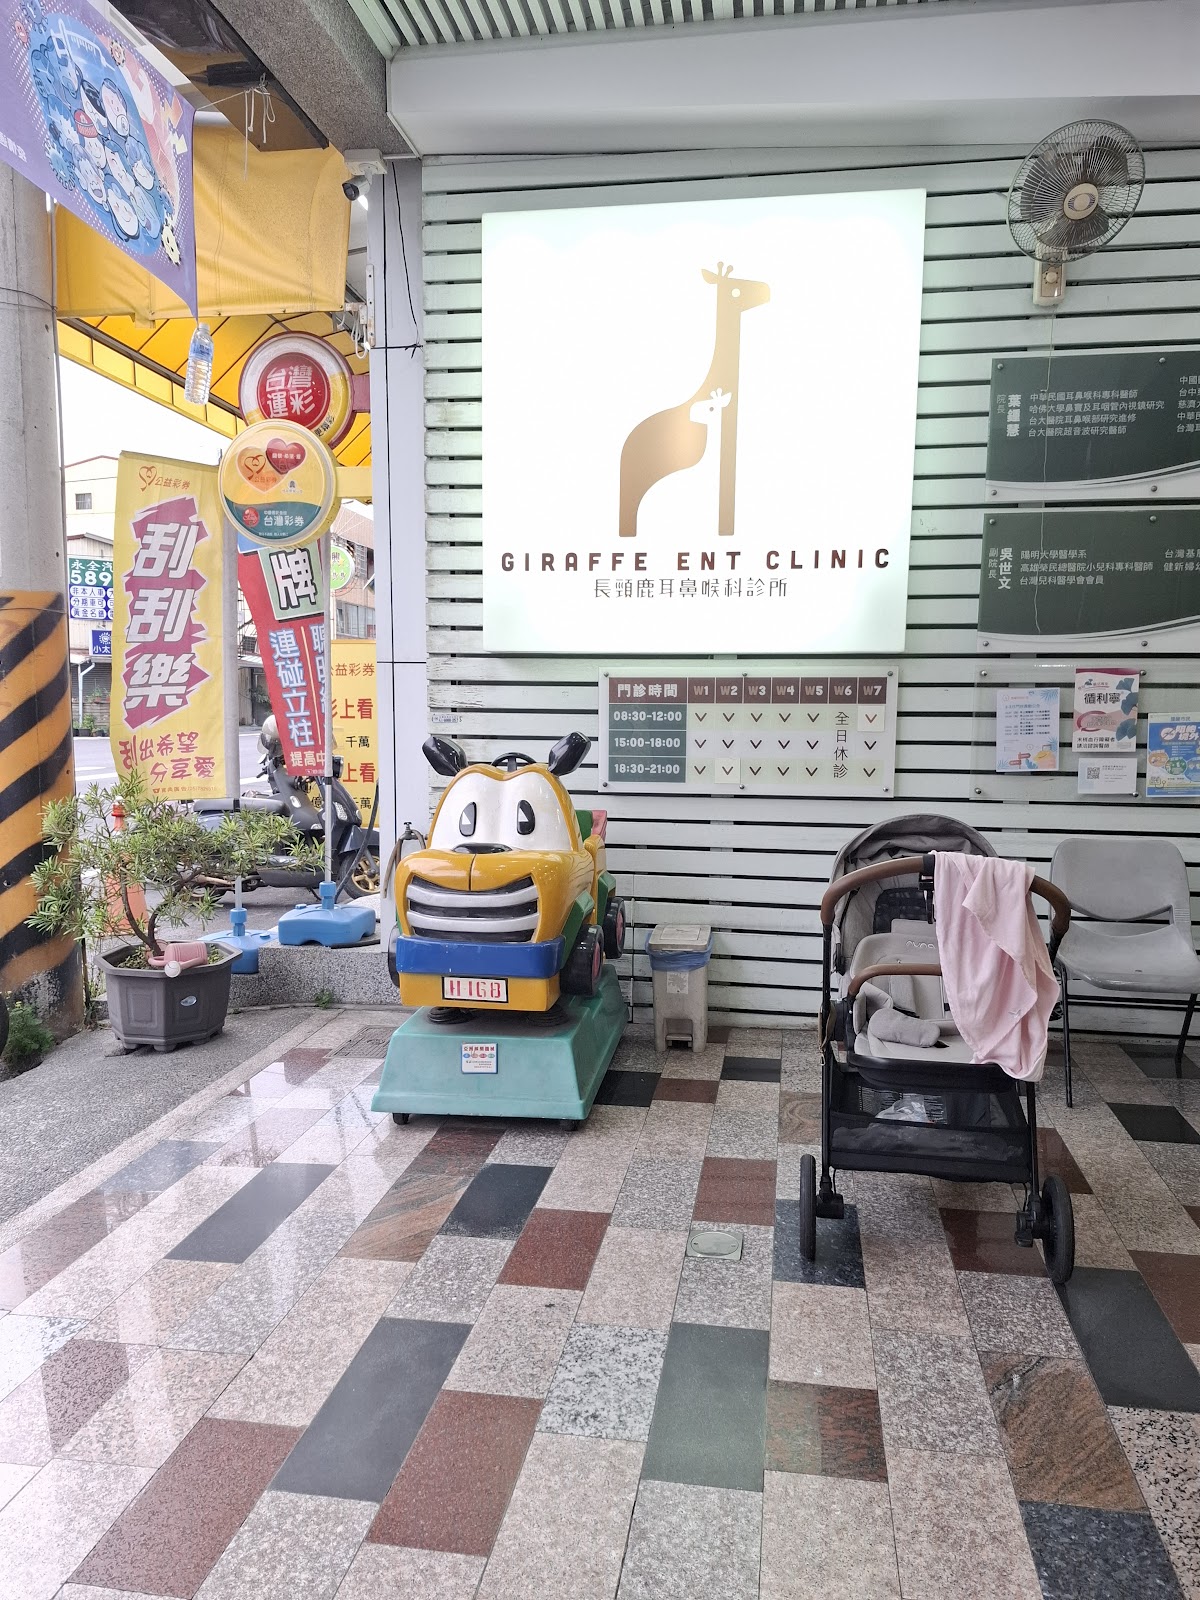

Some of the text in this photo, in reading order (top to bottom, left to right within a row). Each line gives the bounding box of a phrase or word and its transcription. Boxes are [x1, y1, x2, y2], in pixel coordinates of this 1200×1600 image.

[265, 364, 313, 391] 台灣
[1180, 375, 1200, 385] 中國
[1030, 389, 1138, 402] 中華民國耳鼻喉科專科醫師
[1179, 387, 1200, 397] 台中
[266, 388, 315, 418] 運彩
[996, 394, 1007, 414] 院長
[1028, 425, 1127, 438] 台大醫院超音波研究醫師
[155, 476, 190, 490] 公益彩券
[264, 515, 304, 527] 台灣彩券
[501, 548, 890, 572] GIRAFFE ENT CLINIC
[1020, 549, 1087, 560] 陽明大學醫學系
[988, 547, 999, 579] 副院長
[998, 547, 1013, 590] 吳世文
[1020, 561, 1154, 573] 高雄榮民總醫院小兒科專科醫師
[70, 570, 112, 586] 589
[270, 549, 317, 610] 牌
[1020, 574, 1104, 586] 台灣兒科醫學會會員
[594, 577, 788, 598] 長頸鹿耳鼻喉科診所
[126, 522, 200, 710] 刮刮樂
[331, 662, 375, 677] 益彩券
[269, 629, 316, 748] 連碰立柱
[617, 683, 883, 698] 門診時間 W1 W2 W3 W4 W5 W6 W7
[613, 711, 682, 722] 08:30-12:00
[346, 735, 370, 748] 千萬
[614, 737, 680, 748] 15:00-18:00
[832, 711, 850, 779] 全日休診
[118, 731, 199, 770] 刮出希望
[149, 756, 216, 786] 分享愛
[614, 763, 680, 774] 18:30-21:00
[905, 940, 935, 949] nuna
